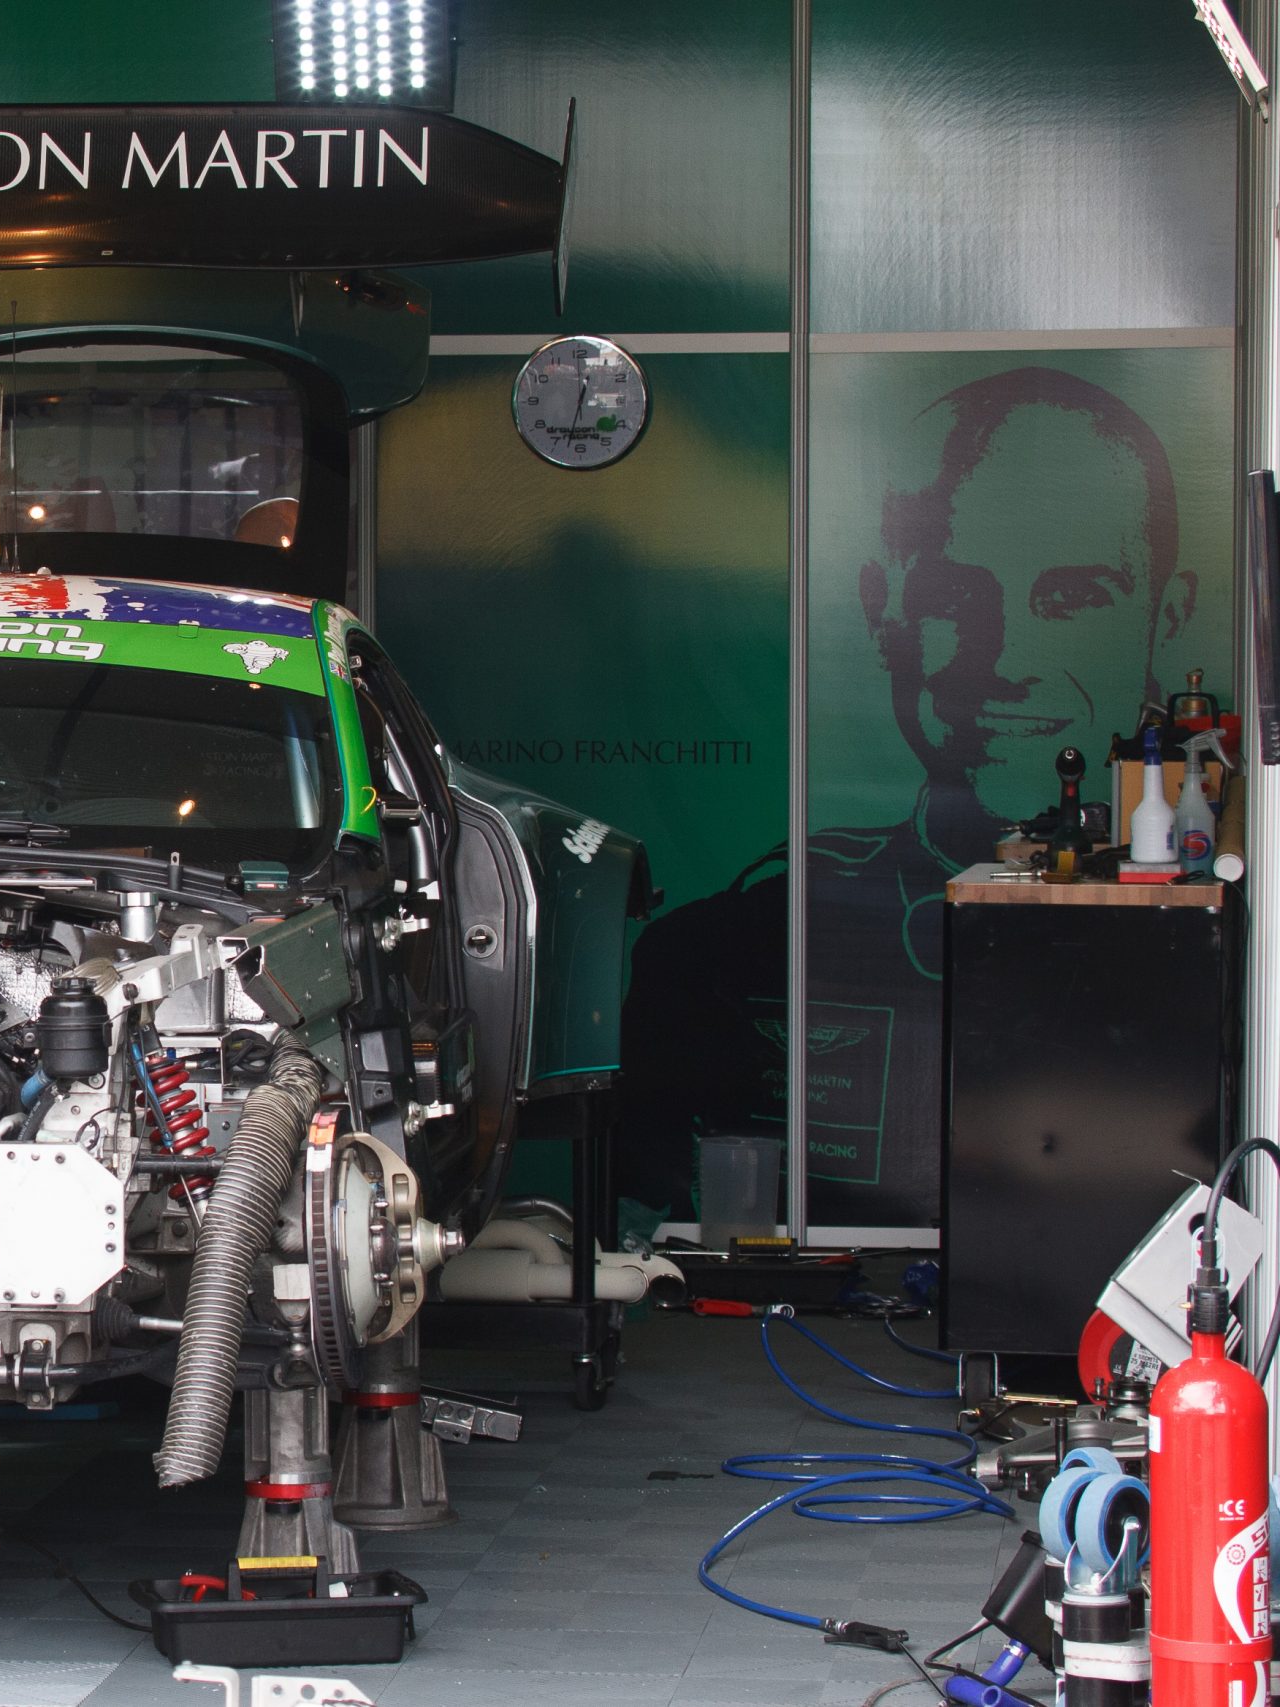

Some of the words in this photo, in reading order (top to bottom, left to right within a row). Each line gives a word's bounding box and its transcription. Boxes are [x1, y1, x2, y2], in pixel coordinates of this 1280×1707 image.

[122, 127, 429, 190] MARTIN
[572, 349, 587, 359] 12
[534, 374, 549, 383] 10
[615, 373, 626, 383] 2
[528, 396, 539, 405] 9
[534, 419, 546, 428] 8
[550, 437, 561, 445] 7
[600, 437, 612, 446] 5
[575, 444, 586, 453] 6
[575, 740, 751, 764] FRANCHITTI
[808, 1141, 857, 1160] RACING
